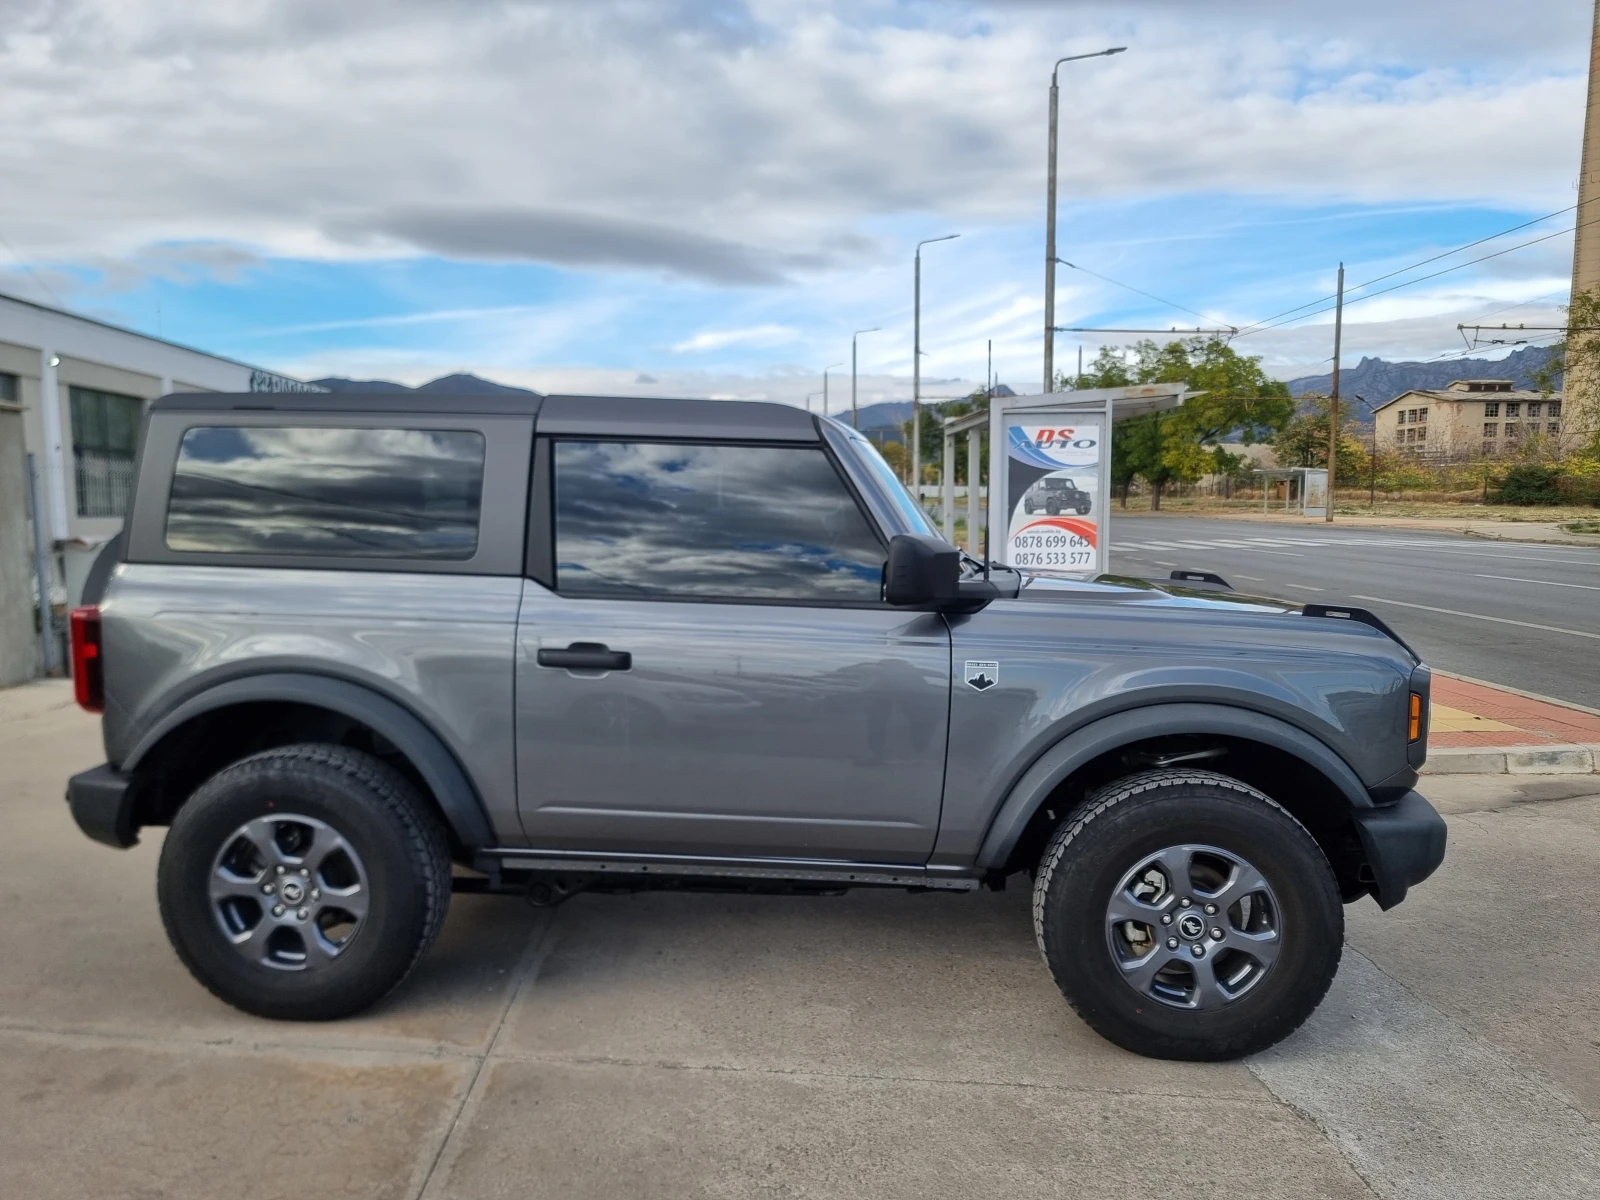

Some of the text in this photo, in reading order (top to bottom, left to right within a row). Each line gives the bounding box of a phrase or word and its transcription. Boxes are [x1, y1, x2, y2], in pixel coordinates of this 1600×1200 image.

[1035, 429, 1075, 444] DS
[1013, 439, 1097, 449] AUTO
[1014, 535, 1091, 549] 0878 699 645
[1015, 552, 1091, 566] 0876 533 577
